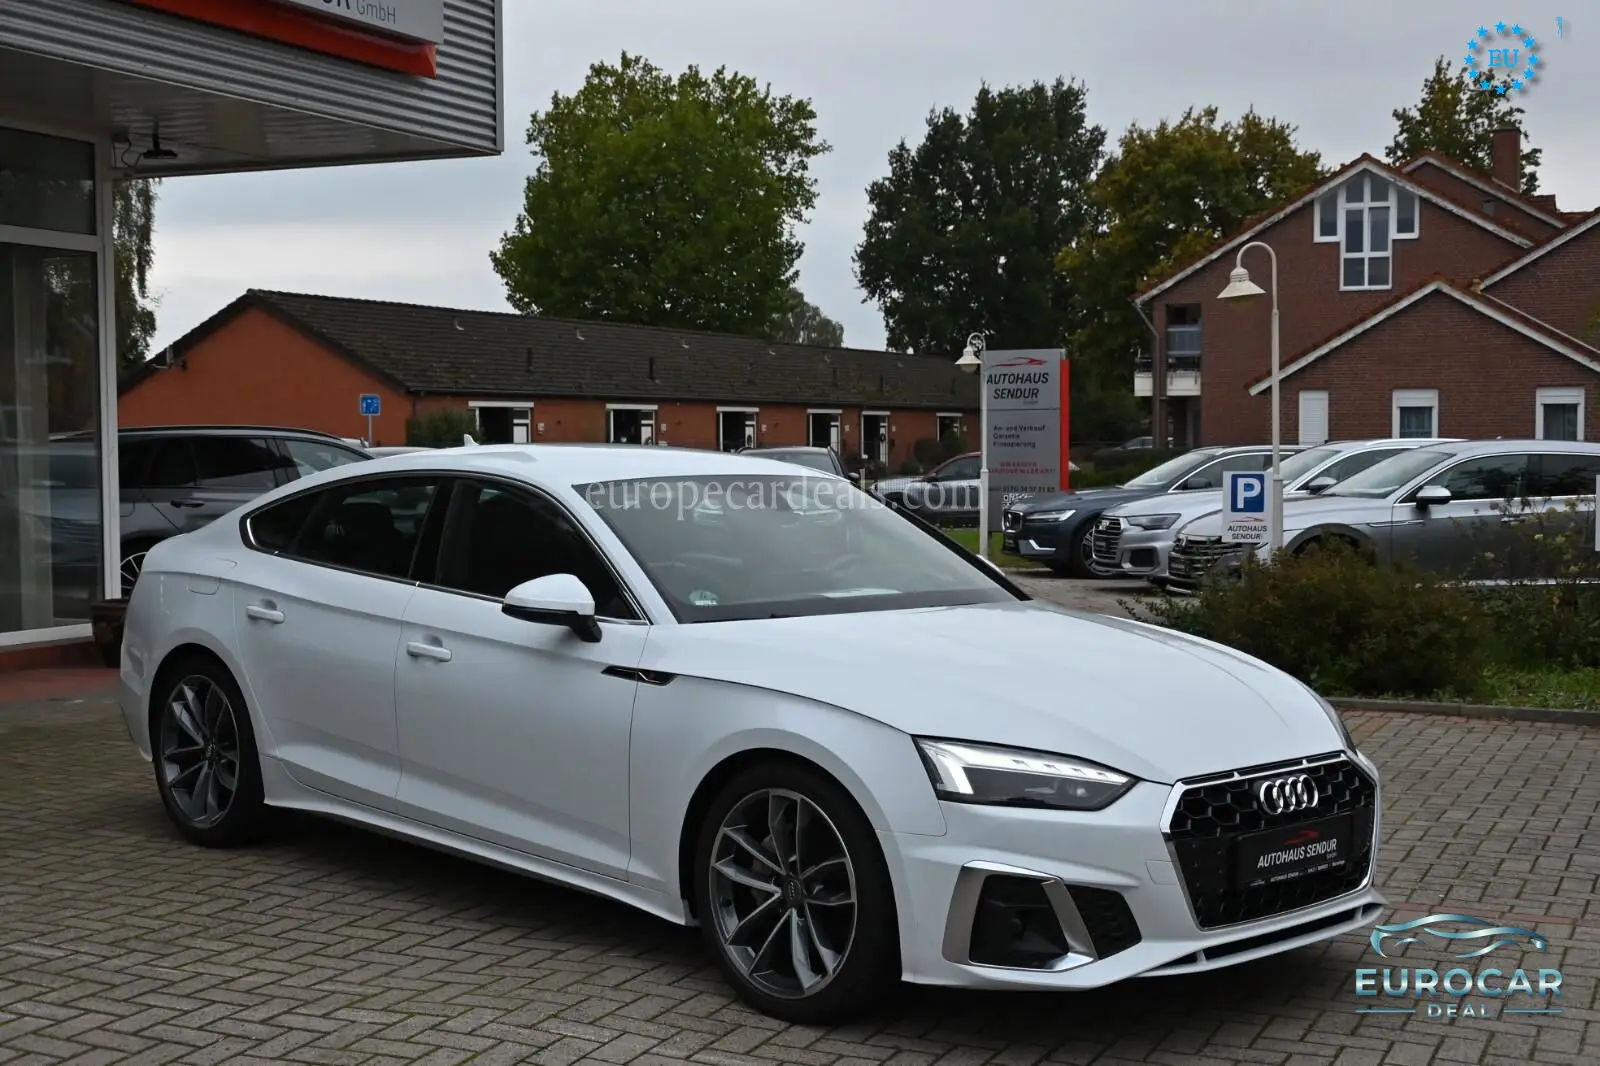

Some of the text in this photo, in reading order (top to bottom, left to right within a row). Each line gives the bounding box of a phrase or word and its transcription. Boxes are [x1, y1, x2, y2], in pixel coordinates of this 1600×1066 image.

[356, 0, 396, 25] GmbH
[986, 372, 1049, 385] AUTOHAUS
[993, 387, 1039, 400] SENDUR
[1237, 477, 1261, 509] P
[1257, 846, 1305, 869] AUTOHAUS
[1306, 838, 1337, 858] SENDUR
